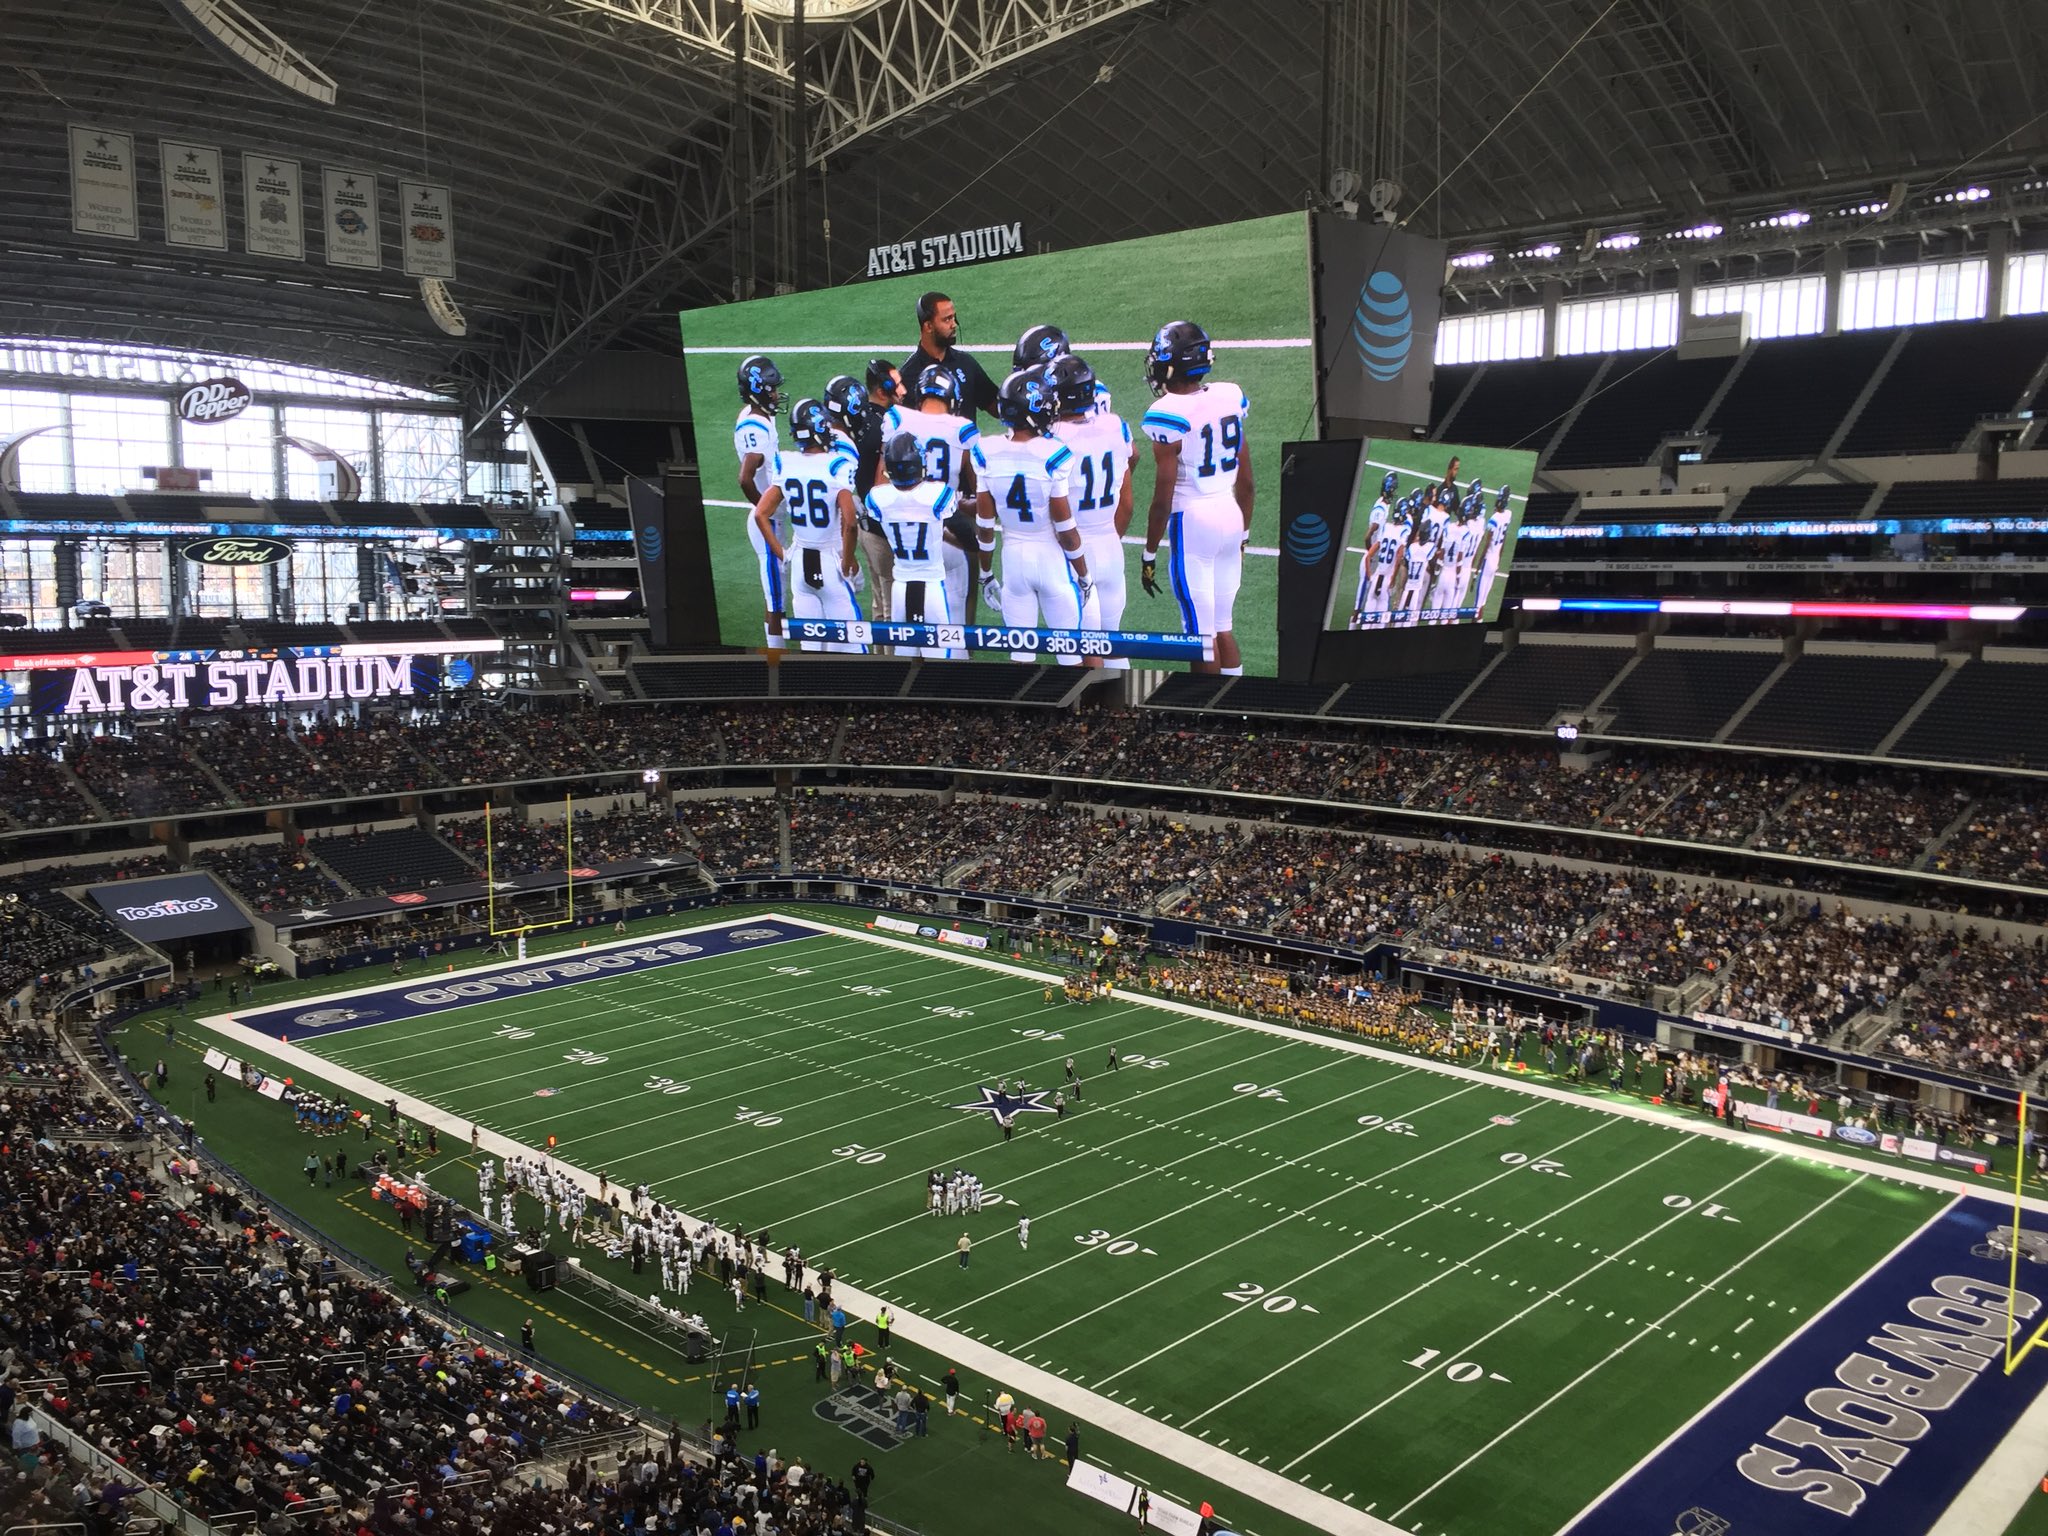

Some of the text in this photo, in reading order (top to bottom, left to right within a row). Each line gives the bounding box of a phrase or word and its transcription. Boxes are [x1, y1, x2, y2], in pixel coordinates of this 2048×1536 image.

[86, 150, 118, 162] DALLAS
[83, 159, 122, 171] COWBOYS
[177, 165, 207, 175] DALLAS
[258, 177, 287, 187] DALLAS
[255, 185, 290, 196] COWBOYS
[337, 190, 364, 200] DALLAS
[334, 198, 368, 208] COWBOYS
[413, 203, 439, 212] DALLAS
[410, 210, 442, 220] COWBOYS
[867, 221, 1024, 277] AT&T STADIUM
[208, 384, 236, 402] Dr
[181, 386, 249, 420] Pepper
[744, 433, 757, 449] 15
[1198, 415, 1242, 478] 19
[1078, 451, 1116, 511] 11
[785, 478, 830, 528] 26
[1005, 473, 1034, 523] 4
[170, 525, 212, 533] COWBOYS
[1562, 528, 1604, 536] COWBOYS
[1661, 523, 1878, 534] BRINGING YOU CLOSER TO YOUR DALLAS COWBOYS
[1947, 522, 1992, 531] BRINGING
[1993, 521, 2014, 530] YOU
[889, 522, 929, 561] 17
[203, 541, 274, 561] Ford
[1378, 538, 1397, 564] 26
[1408, 561, 1424, 580] 17
[803, 623, 827, 637] SC
[837, 629, 846, 641] 3
[854, 626, 864, 637] 9
[889, 626, 915, 641] HP
[924, 625, 936, 633] TO
[940, 629, 961, 642] 24
[926, 634, 935, 646] 3
[974, 628, 1039, 650] 12:00
[1081, 631, 1109, 640] DOWN
[1121, 633, 1135, 641] TO
[1135, 634, 1149, 642] GO
[1162, 635, 1187, 643] BALL
[1187, 635, 1202, 643] ON
[314, 648, 322, 656] 9
[1046, 637, 1112, 655] 3RD 3RD
[14, 657, 76, 667] Bank of America
[179, 652, 192, 660] 24
[219, 650, 244, 659] 12:00
[64, 655, 415, 714] AT&T STADIUM
[404, 941, 704, 1005] COWBOYS
[776, 966, 814, 977] 10
[850, 984, 893, 997] 20
[931, 1005, 975, 1018] 30
[493, 1025, 536, 1040] 10
[1021, 1029, 1066, 1042] 40
[562, 1049, 610, 1066] 20
[1121, 1054, 1170, 1070] 50
[643, 1077, 691, 1096] 30
[1232, 1083, 1284, 1100] 40
[732, 1110, 784, 1128] 40
[1357, 1114, 1415, 1135] 30
[831, 1143, 887, 1166] 50
[1499, 1152, 1566, 1174] 20
[1662, 1194, 1731, 1219] 10
[1073, 1228, 1139, 1257] 30
[1221, 1281, 1298, 1314] 20
[1401, 1345, 1485, 1384] 10
[830, 1394, 853, 1408] State
[1735, 1275, 2042, 1517] COWBOYS
